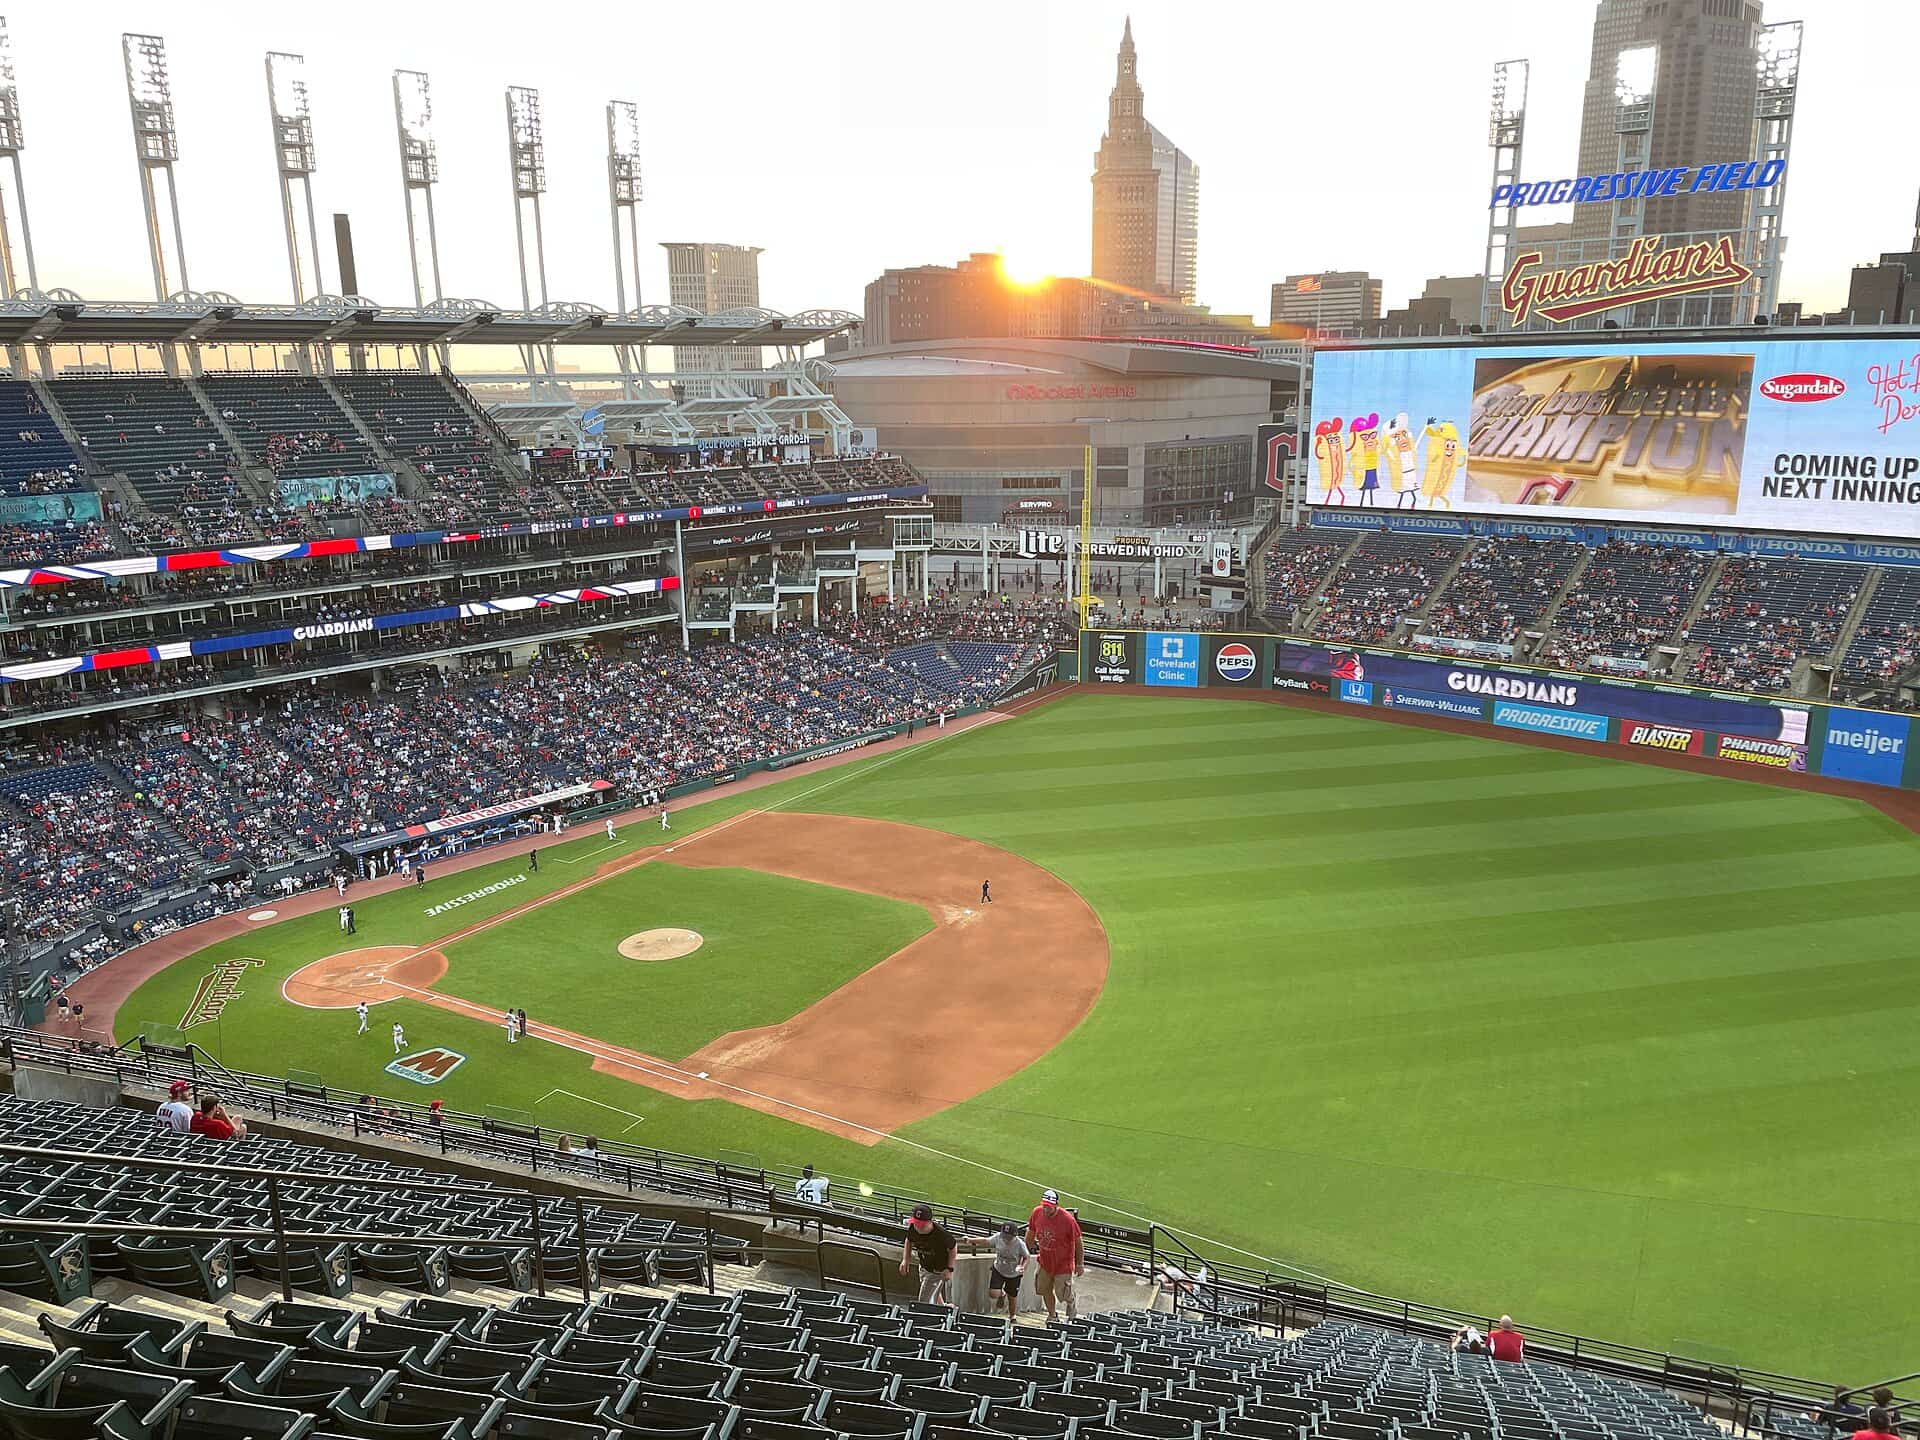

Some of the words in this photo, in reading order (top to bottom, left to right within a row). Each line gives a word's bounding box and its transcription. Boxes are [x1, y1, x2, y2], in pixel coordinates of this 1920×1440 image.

[1489, 167, 1688, 209] PROGRESSIVE
[1690, 159, 1785, 193] FIELD
[1502, 235, 1752, 327] Guardians
[1763, 379, 1843, 398] Sugardale
[743, 433, 777, 448] TERRACE
[779, 433, 810, 445] GARDEN
[1774, 454, 1877, 477] COMING
[1884, 457, 1919, 480] UP
[1762, 477, 1828, 500] NEXT
[1832, 479, 1920, 504] INNING
[1331, 512, 1385, 525] HONDA
[1404, 517, 1463, 530] HONDA
[1510, 524, 1577, 537] HONDA
[1632, 532, 1705, 545] HONDA
[1017, 529, 1063, 558] Lite
[1116, 537, 1150, 545] PROUDLY
[1766, 540, 1847, 554] HONDA
[1138, 545, 1150, 557] IN
[1154, 546, 1184, 557] OHIO
[293, 618, 373, 640] GUARDIANS
[1102, 641, 1122, 657] 811
[1149, 658, 1196, 669] Cleveland
[1219, 656, 1253, 667] PEPSI
[1159, 671, 1185, 681] Clinic
[1273, 676, 1309, 689] KeyBank
[1447, 671, 1577, 706] GUARDIANS
[1497, 707, 1601, 735] PROGRESSIVE
[1630, 726, 1692, 751] BLASTER
[1722, 736, 1793, 757] PHANTOM
[1828, 729, 1904, 754] meijer
[1719, 748, 1790, 767] FIREWORKS
[438, 799, 539, 827] CLEVELAND
[424, 874, 527, 917] PROGRESSIVE
